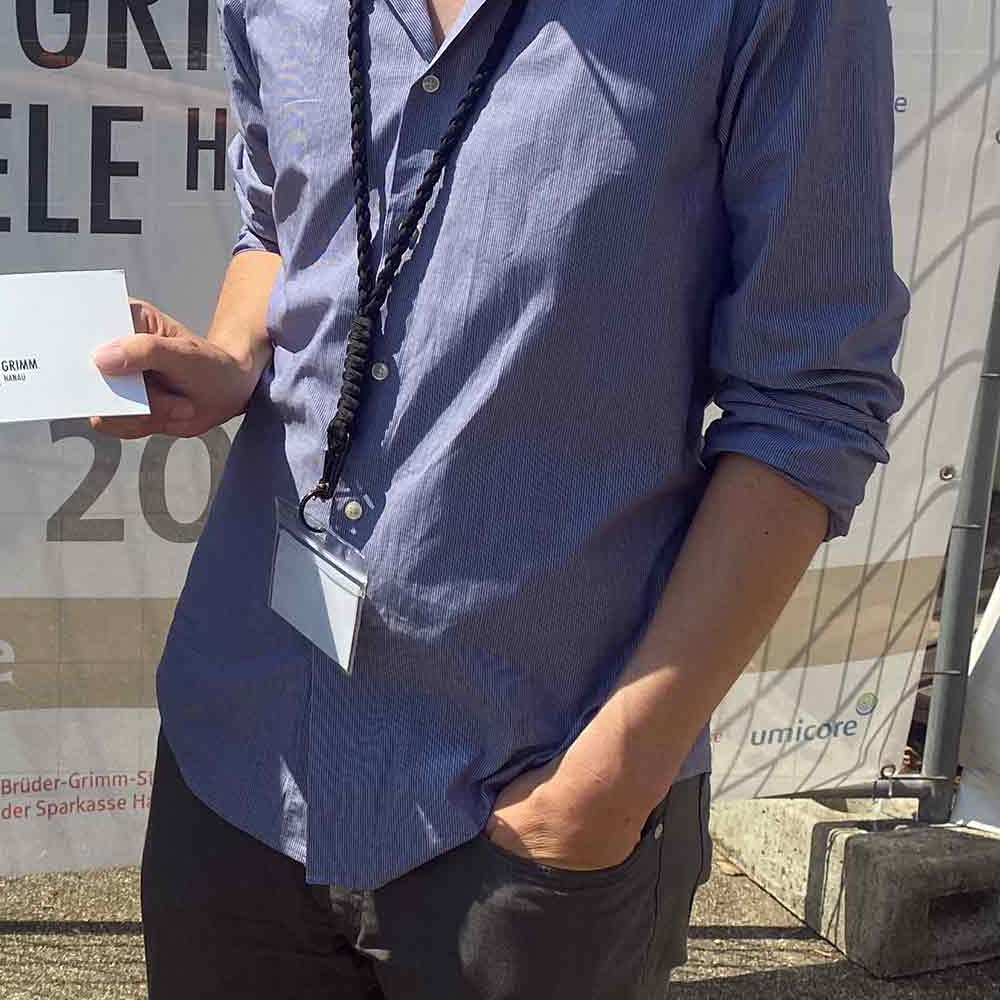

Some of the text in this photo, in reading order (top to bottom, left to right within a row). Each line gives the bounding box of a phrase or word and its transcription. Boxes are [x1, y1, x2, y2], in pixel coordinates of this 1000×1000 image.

[1, 358, 38, 372] GRIMM
[751, 719, 857, 746] umicore
[1, 802, 31, 820] der
[36, 795, 127, 820] Sparkasse
